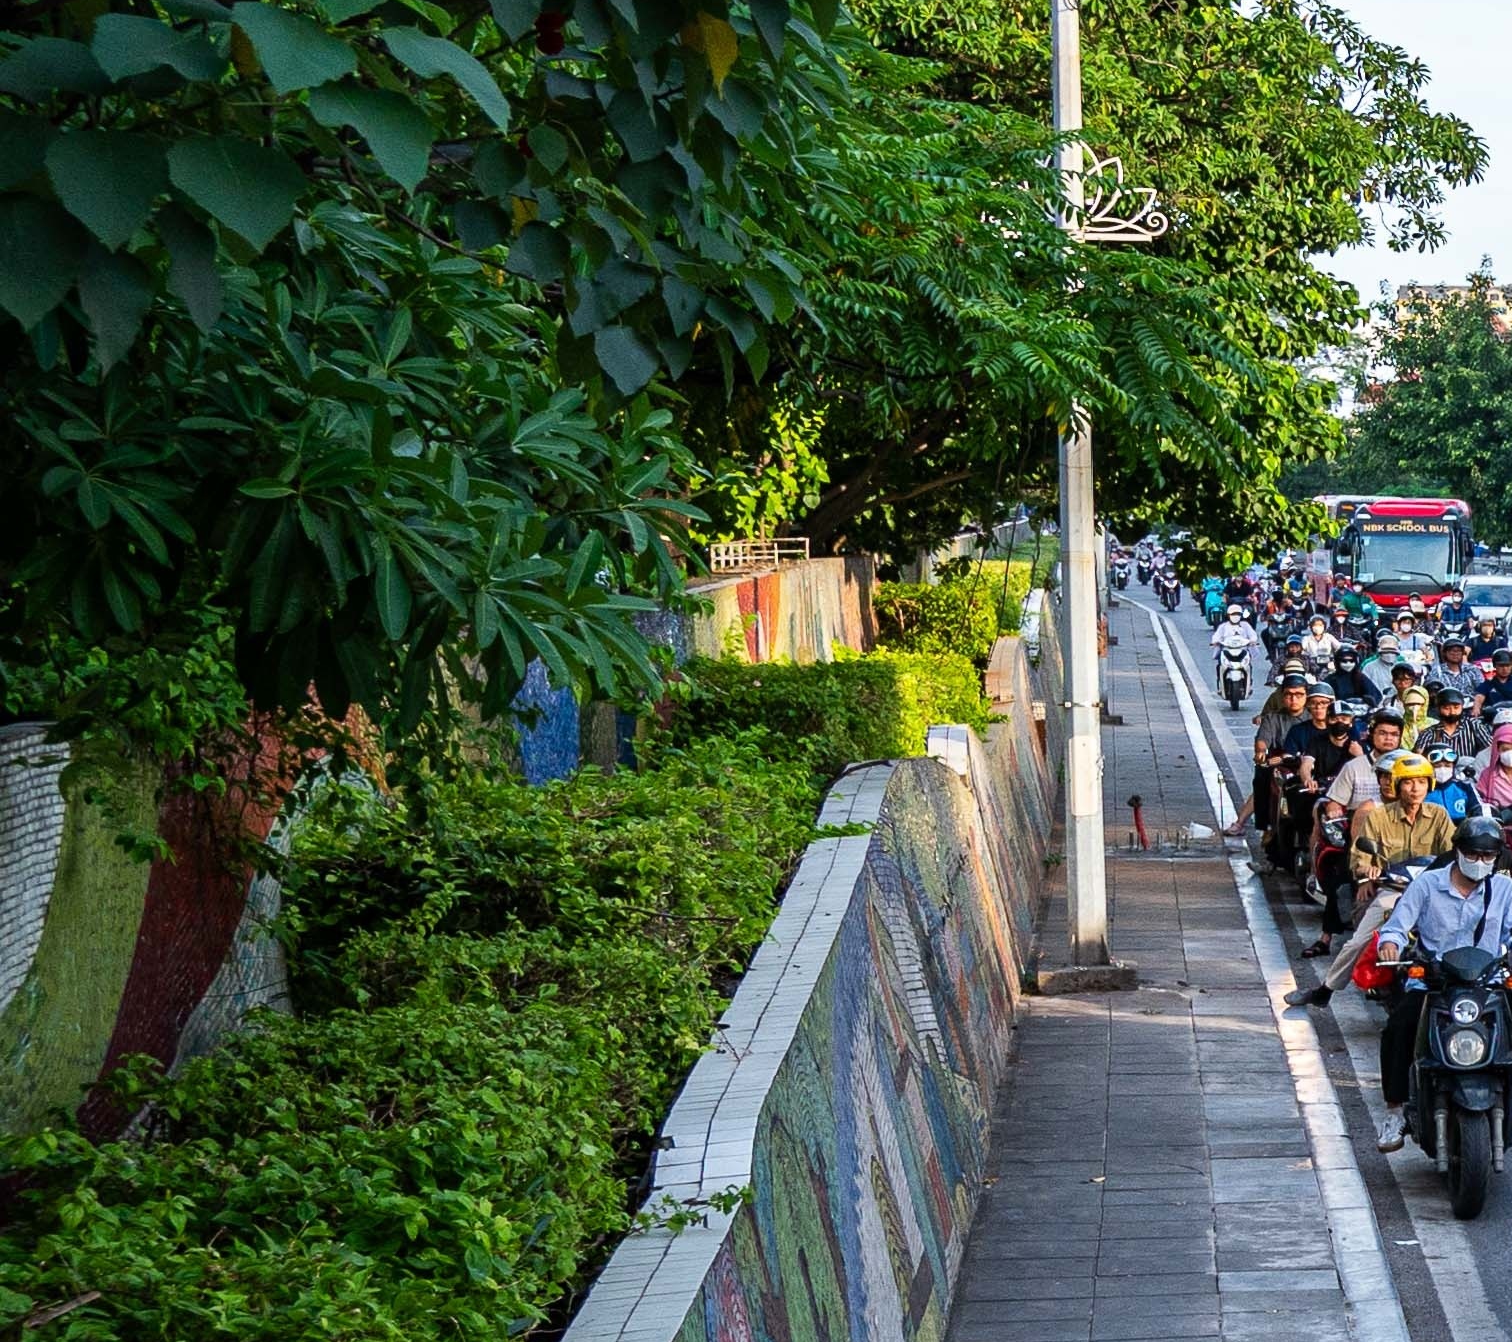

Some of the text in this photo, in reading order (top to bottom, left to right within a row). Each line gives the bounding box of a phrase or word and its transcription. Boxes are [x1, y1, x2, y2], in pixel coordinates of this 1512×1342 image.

[1363, 524, 1450, 533] NBK SCHOOL BUS
